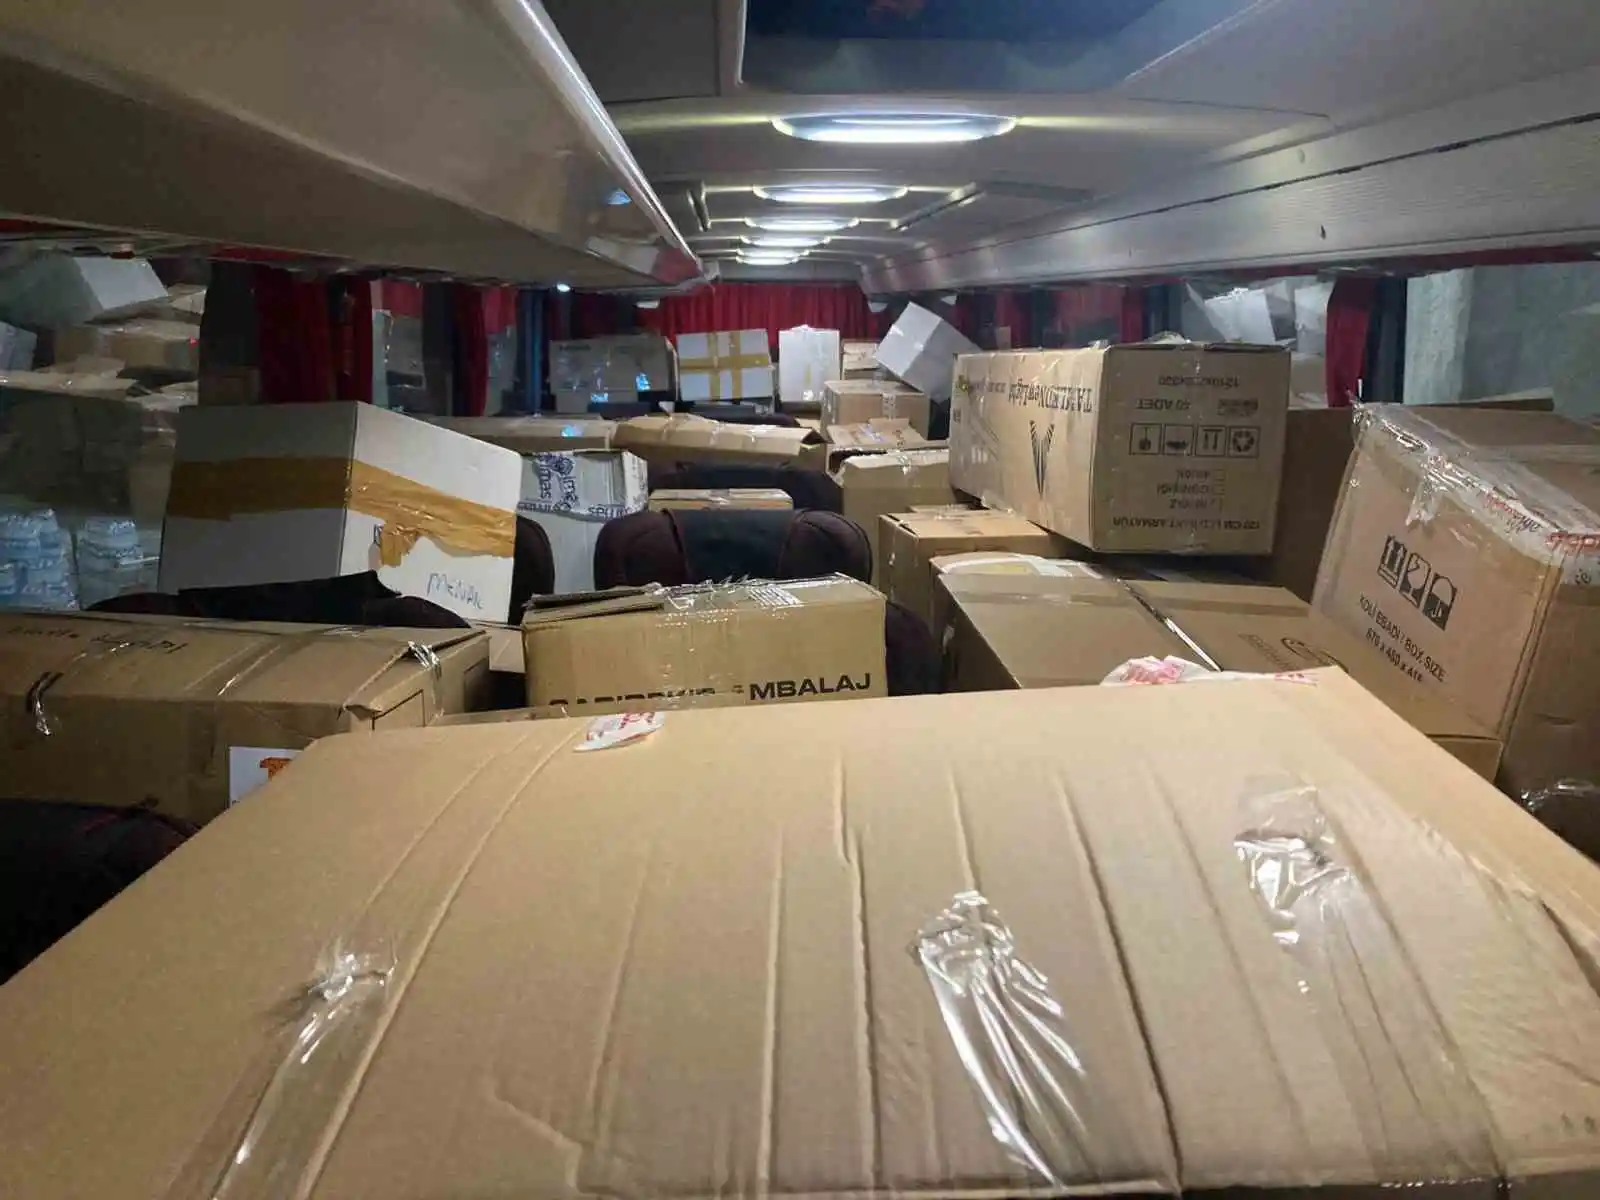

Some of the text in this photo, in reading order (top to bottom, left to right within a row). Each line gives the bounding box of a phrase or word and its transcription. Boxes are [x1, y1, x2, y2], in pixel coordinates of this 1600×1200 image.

[1136, 399, 1173, 410] ADET
[1404, 637, 1424, 661] BOX
[1423, 655, 1446, 682] SIZE
[733, 672, 871, 701] MBALAJ
